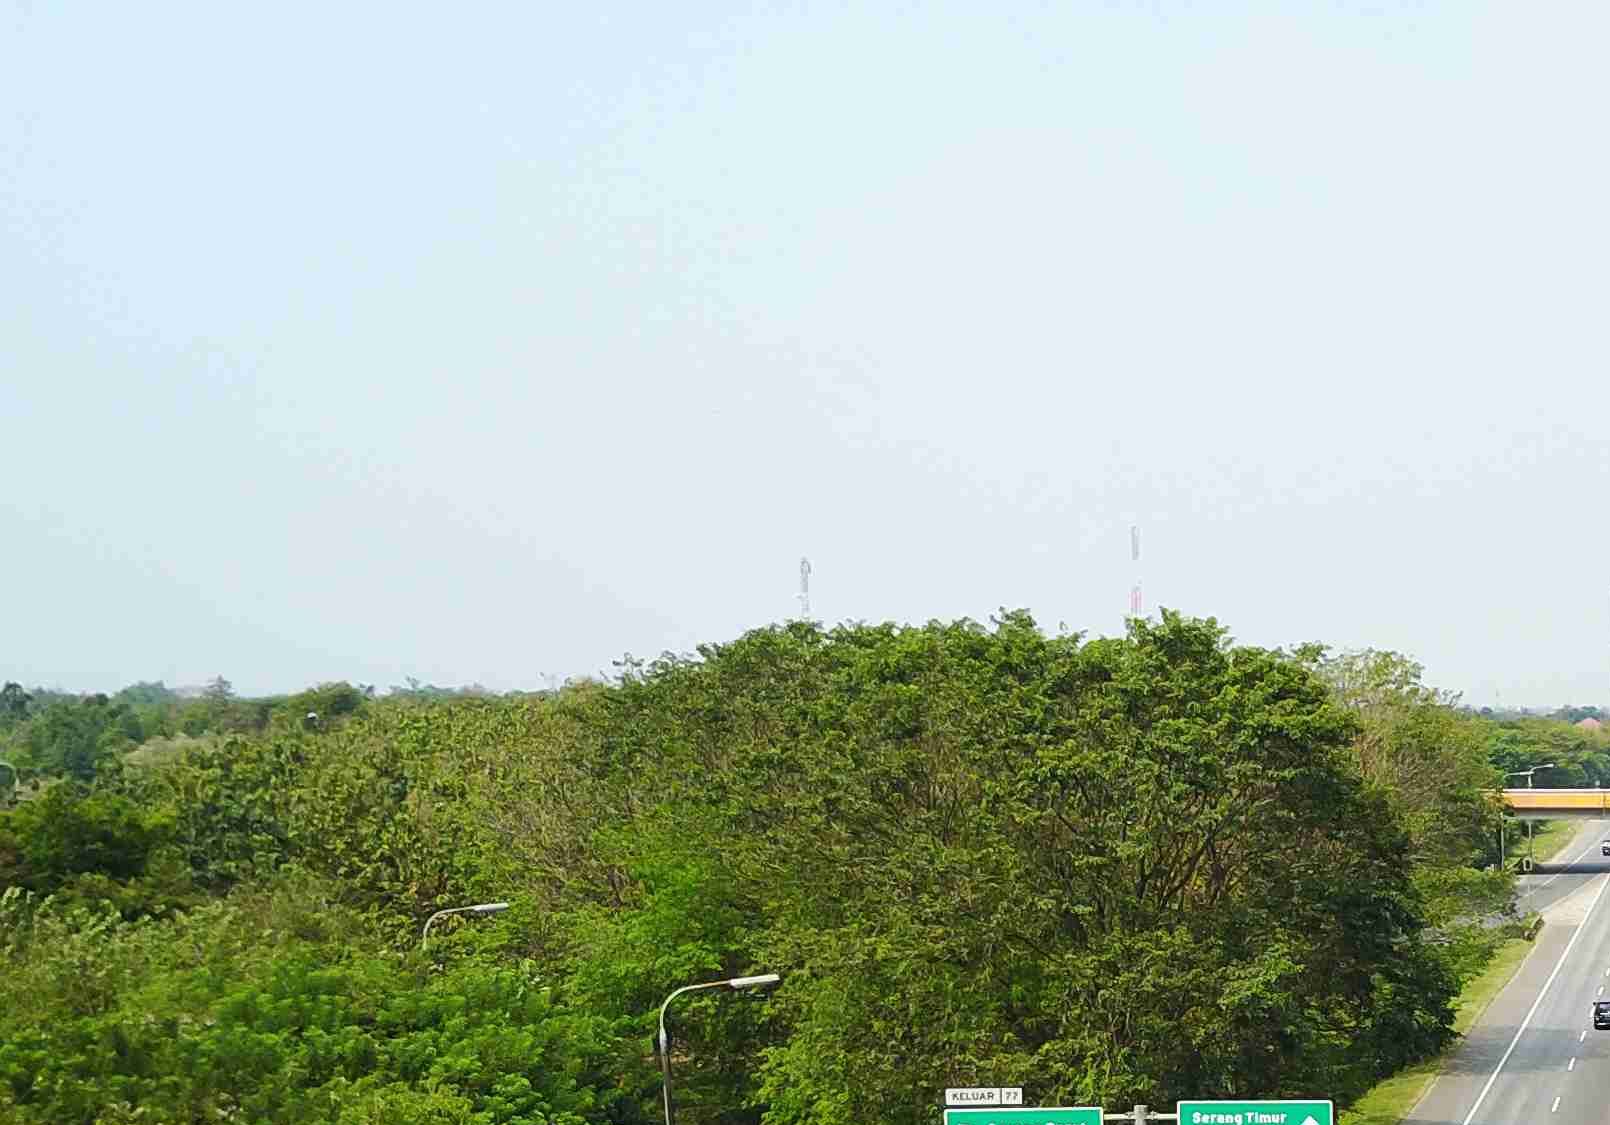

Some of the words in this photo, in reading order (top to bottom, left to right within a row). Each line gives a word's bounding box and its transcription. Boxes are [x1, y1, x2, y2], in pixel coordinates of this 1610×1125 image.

[952, 1092, 994, 1101] KELUAR
[1005, 1091, 1018, 1100] 77
[1192, 1111, 1243, 1125] Serang
[1245, 1111, 1287, 1124] Timur
